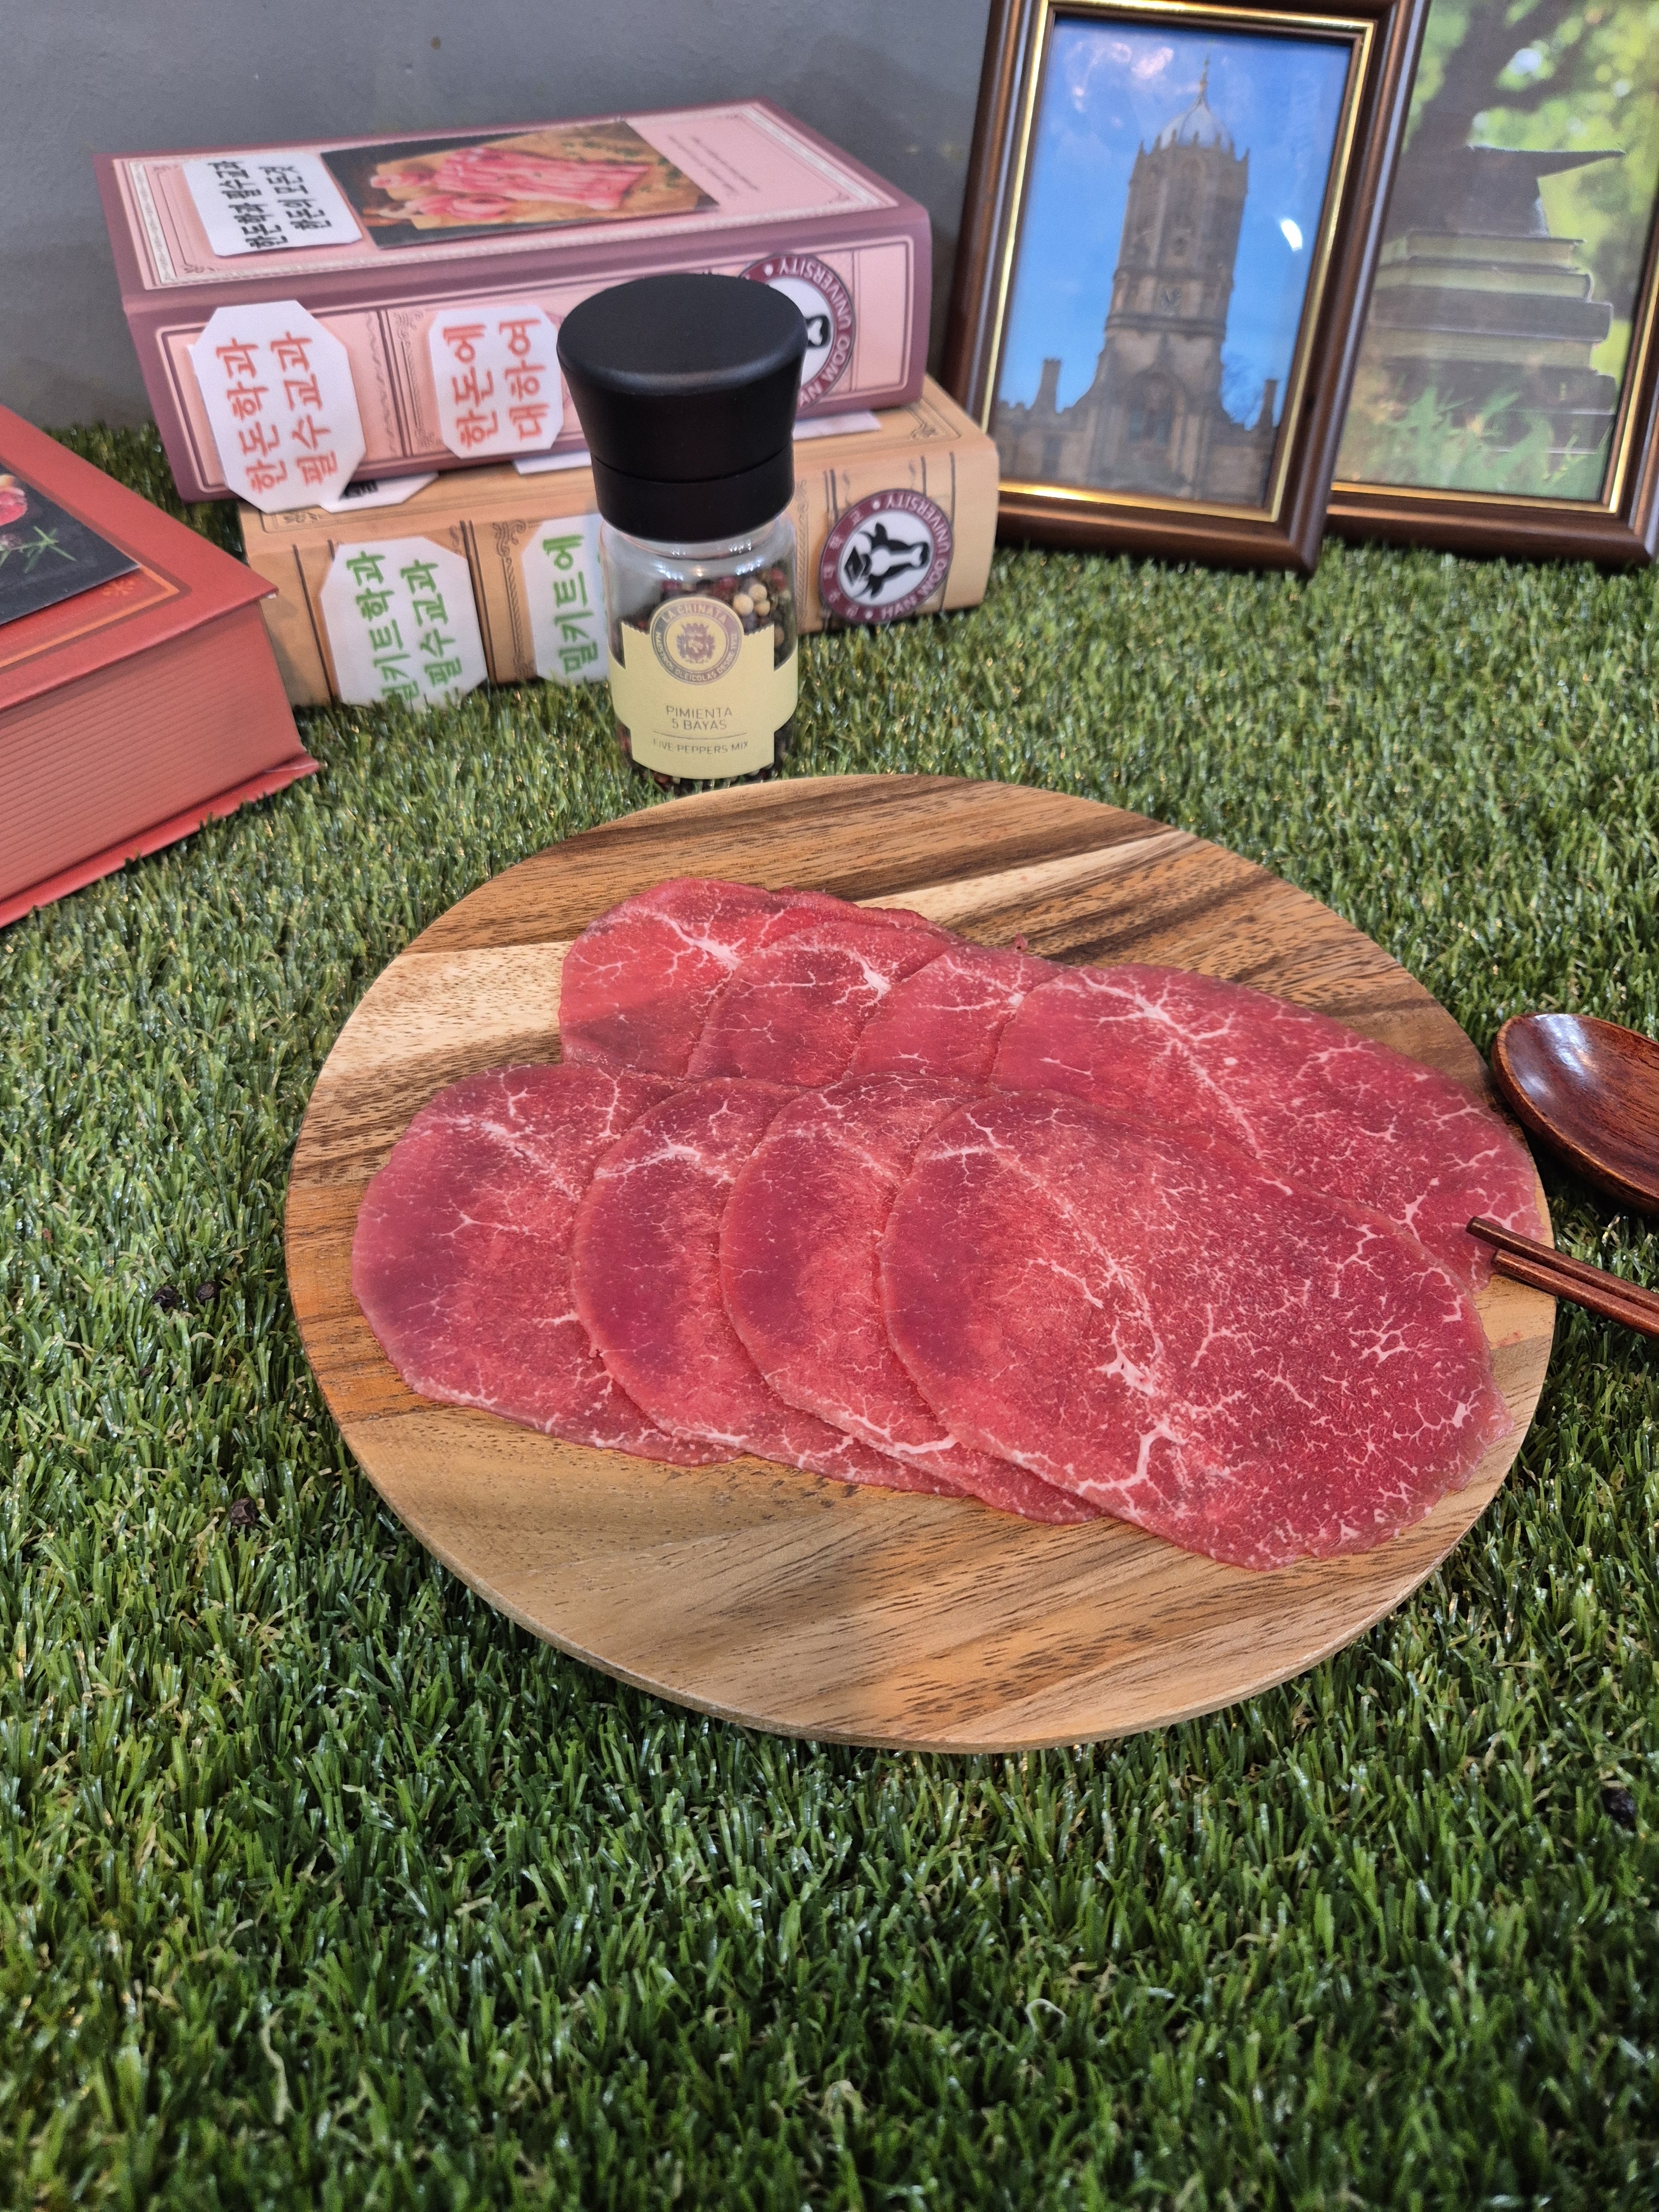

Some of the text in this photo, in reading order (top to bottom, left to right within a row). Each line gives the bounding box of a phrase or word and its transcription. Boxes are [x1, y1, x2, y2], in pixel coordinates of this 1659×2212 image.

[207, 160, 289, 249] 한돈학과 필수교과
[278, 199, 332, 230] 한돈의
[499, 319, 550, 441] 대하여
[779, 257, 852, 407] AN WOO UNIVERSITY
[215, 337, 288, 494] 한돈학과
[270, 331, 338, 487] 필수교과
[443, 324, 498, 450] 한돈에
[886, 495, 951, 554] UNIVERSITY
[400, 559, 462, 687] 필수교과
[542, 534, 599, 675] 밀키트에
[661, 603, 727, 624] LA CHINATA
[653, 738, 749, 755] FIVE PEPPERS MIX
[666, 705, 733, 718] PIMIENTA
[671, 719, 727, 731] 5 BAYAS
